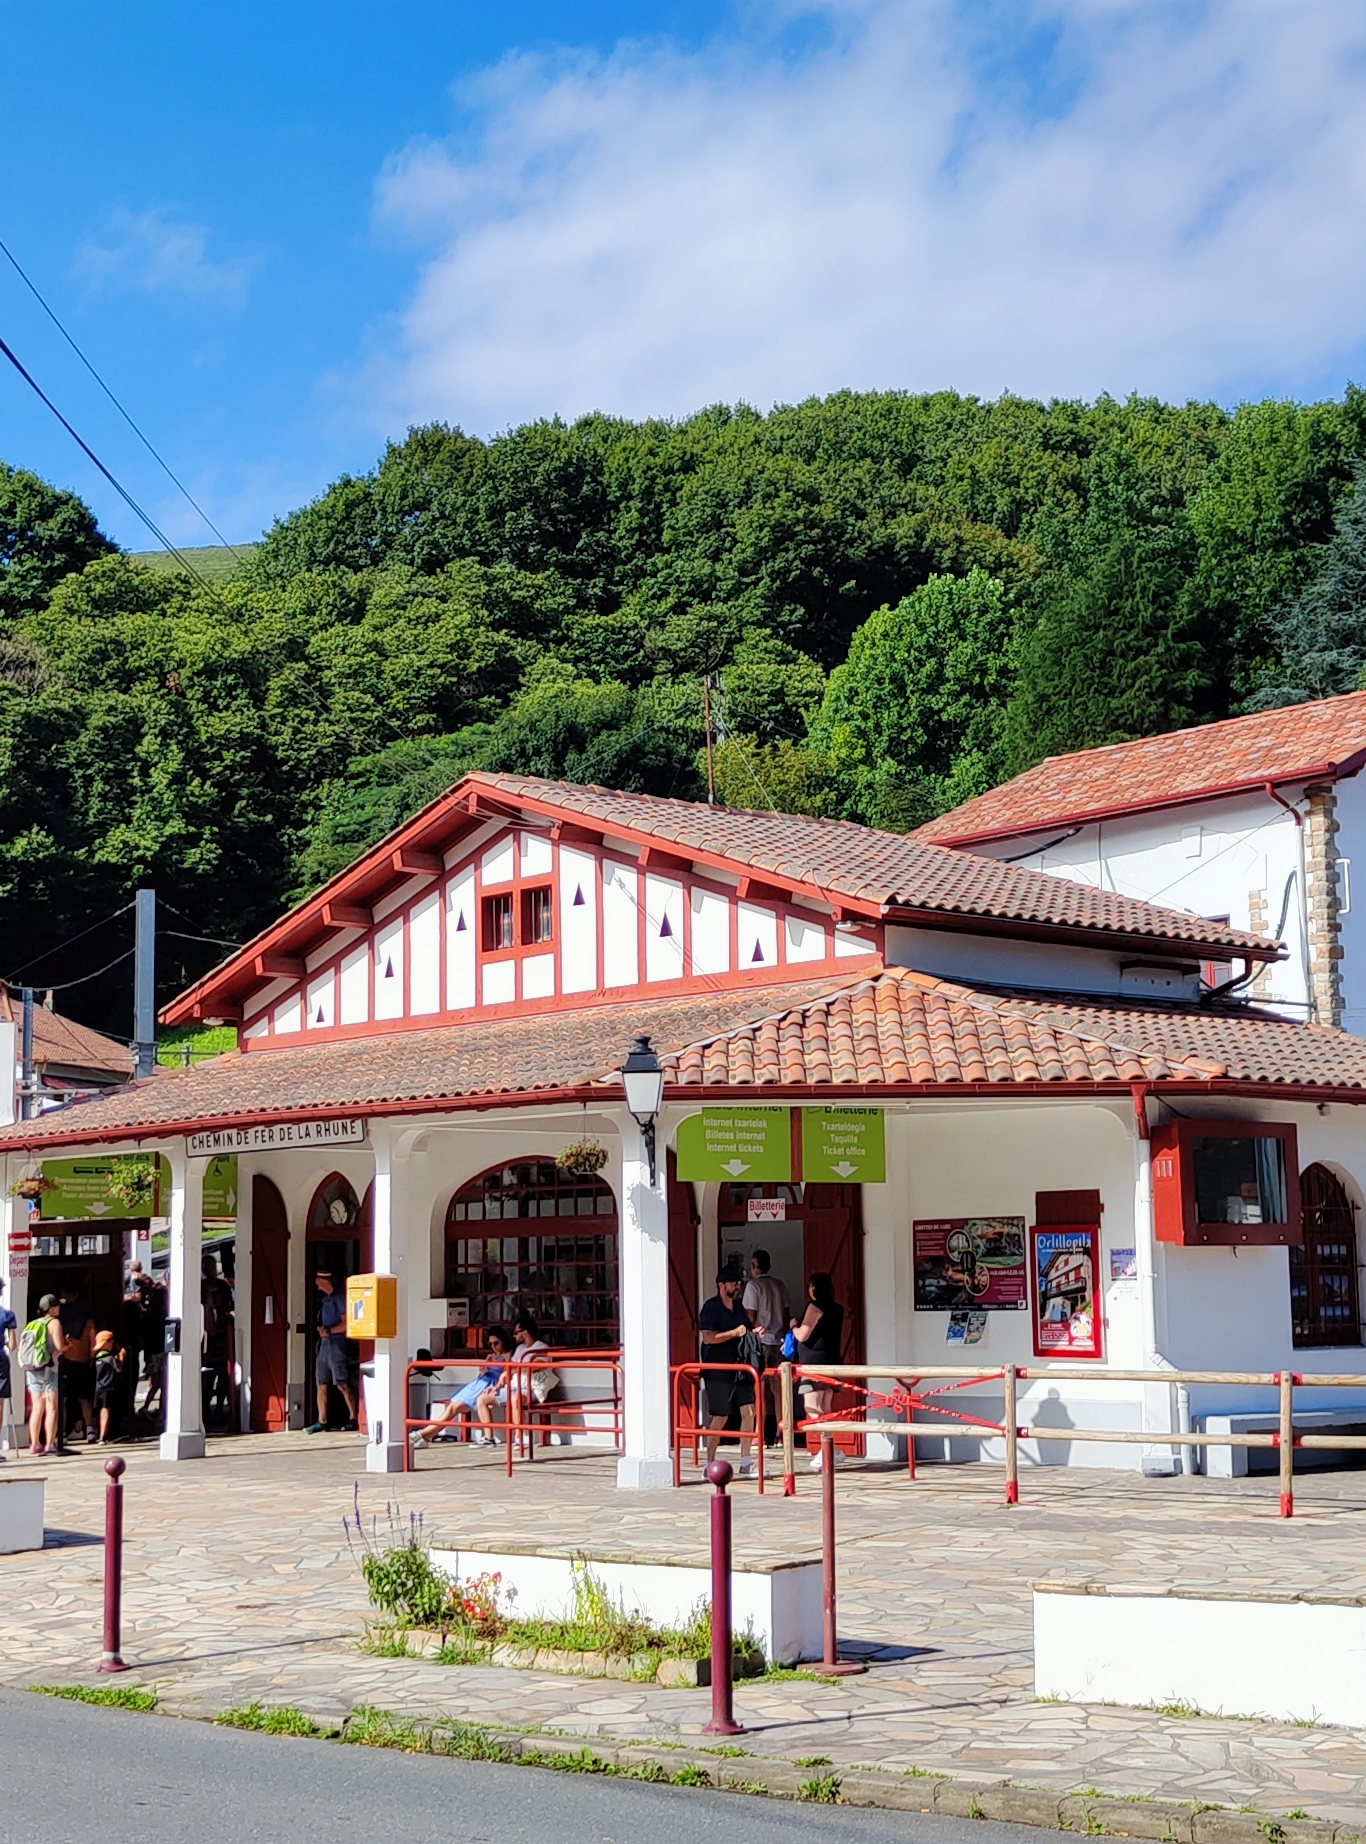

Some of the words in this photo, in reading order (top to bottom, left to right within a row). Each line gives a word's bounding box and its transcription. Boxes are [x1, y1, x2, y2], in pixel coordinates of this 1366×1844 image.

[703, 1117, 734, 1128] Internet
[191, 1132, 233, 1150] CHEMIN
[236, 1131, 250, 1146] DE
[254, 1129, 275, 1144] FER
[279, 1127, 294, 1142] DE
[298, 1124, 311, 1139] LA
[316, 1120, 357, 1138] RHUNE
[706, 1143, 737, 1153] Internet
[738, 1143, 764, 1153] tickets
[822, 1146, 845, 1155] Ticket
[845, 1146, 866, 1156] office
[749, 1201, 785, 1211] Billetterie
[139, 1230, 148, 1240] 2
